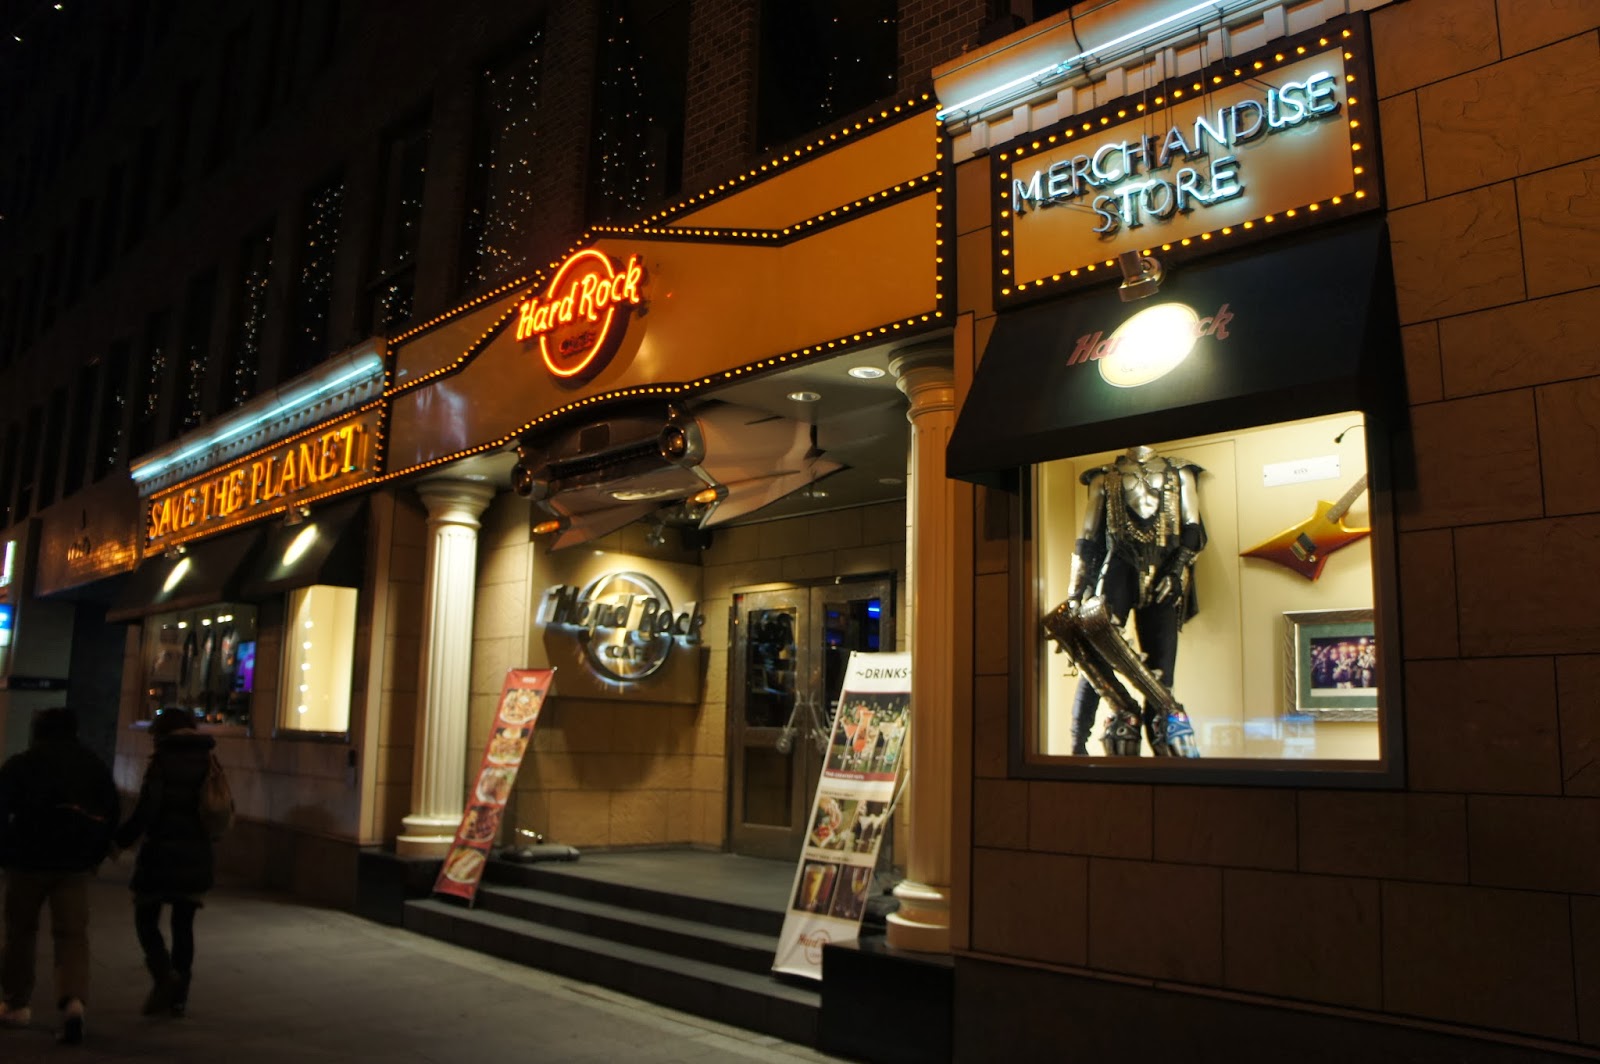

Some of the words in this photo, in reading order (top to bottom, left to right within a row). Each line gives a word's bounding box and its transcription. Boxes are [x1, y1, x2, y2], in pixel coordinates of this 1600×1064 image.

[1012, 71, 1342, 216] MERCHANDISE
[1092, 155, 1245, 240] STORE
[516, 281, 579, 342] Hard
[578, 254, 642, 322] Rock
[1066, 330, 1123, 366] Har
[149, 488, 198, 540] SAVE
[200, 469, 246, 522] THE
[250, 423, 364, 506] PLANET
[631, 595, 706, 640] Rock
